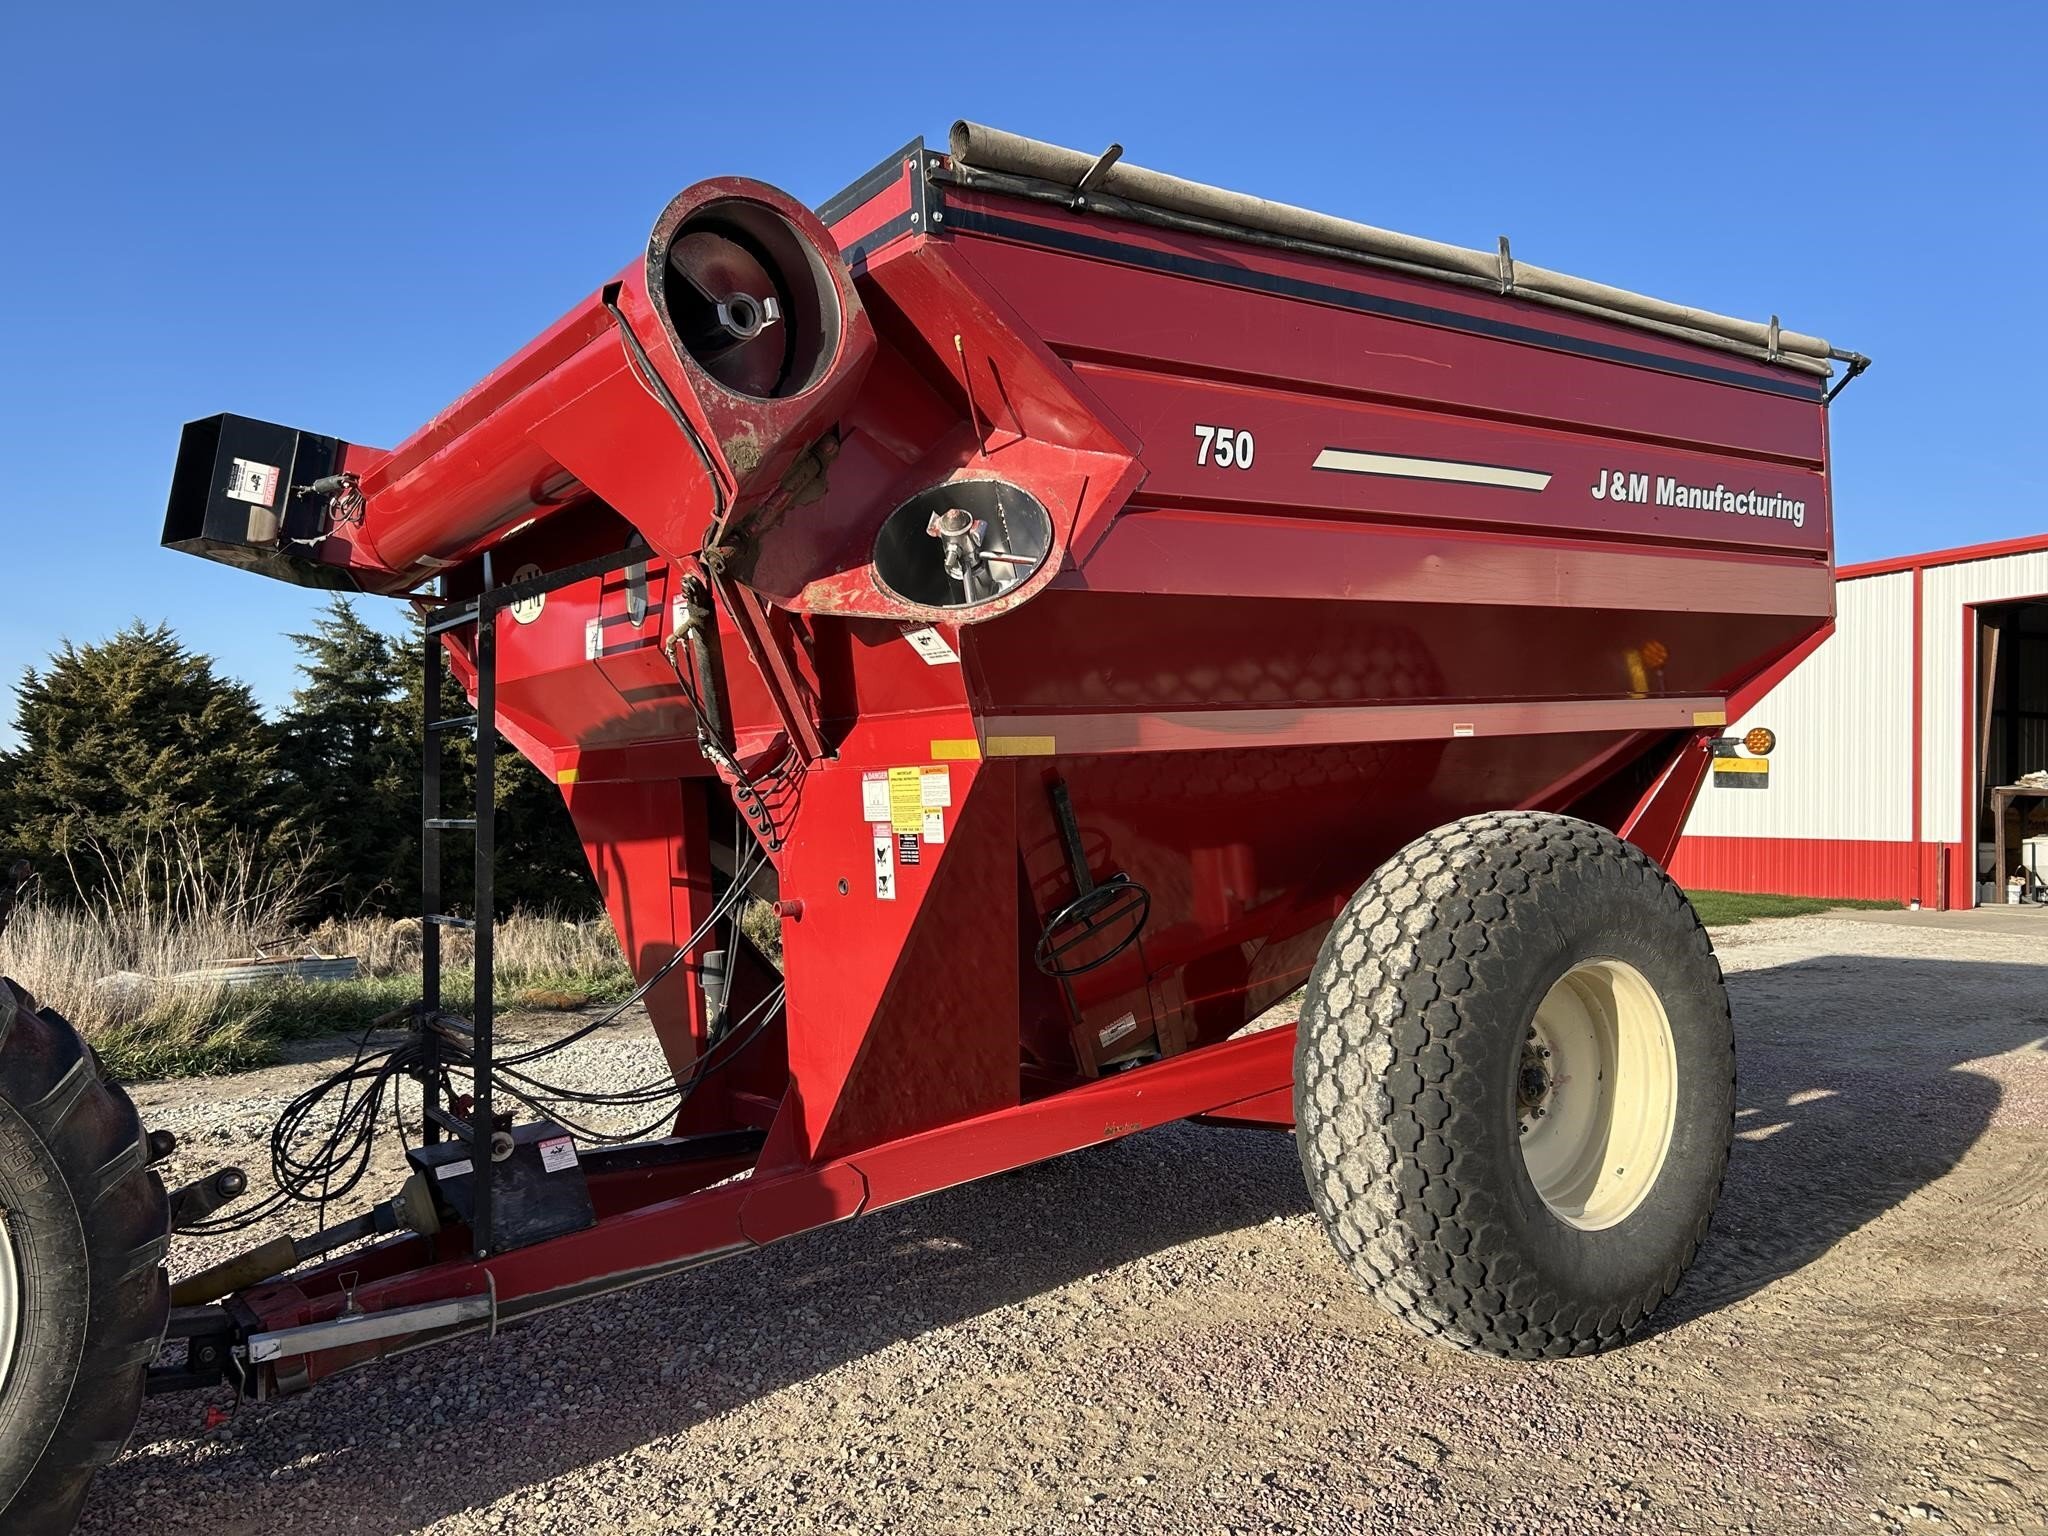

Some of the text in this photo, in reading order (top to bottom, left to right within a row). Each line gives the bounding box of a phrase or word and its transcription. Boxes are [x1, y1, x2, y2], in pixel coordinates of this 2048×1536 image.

[1195, 424, 1255, 470] 750
[1591, 469, 1806, 528] J&M Manufacturing
